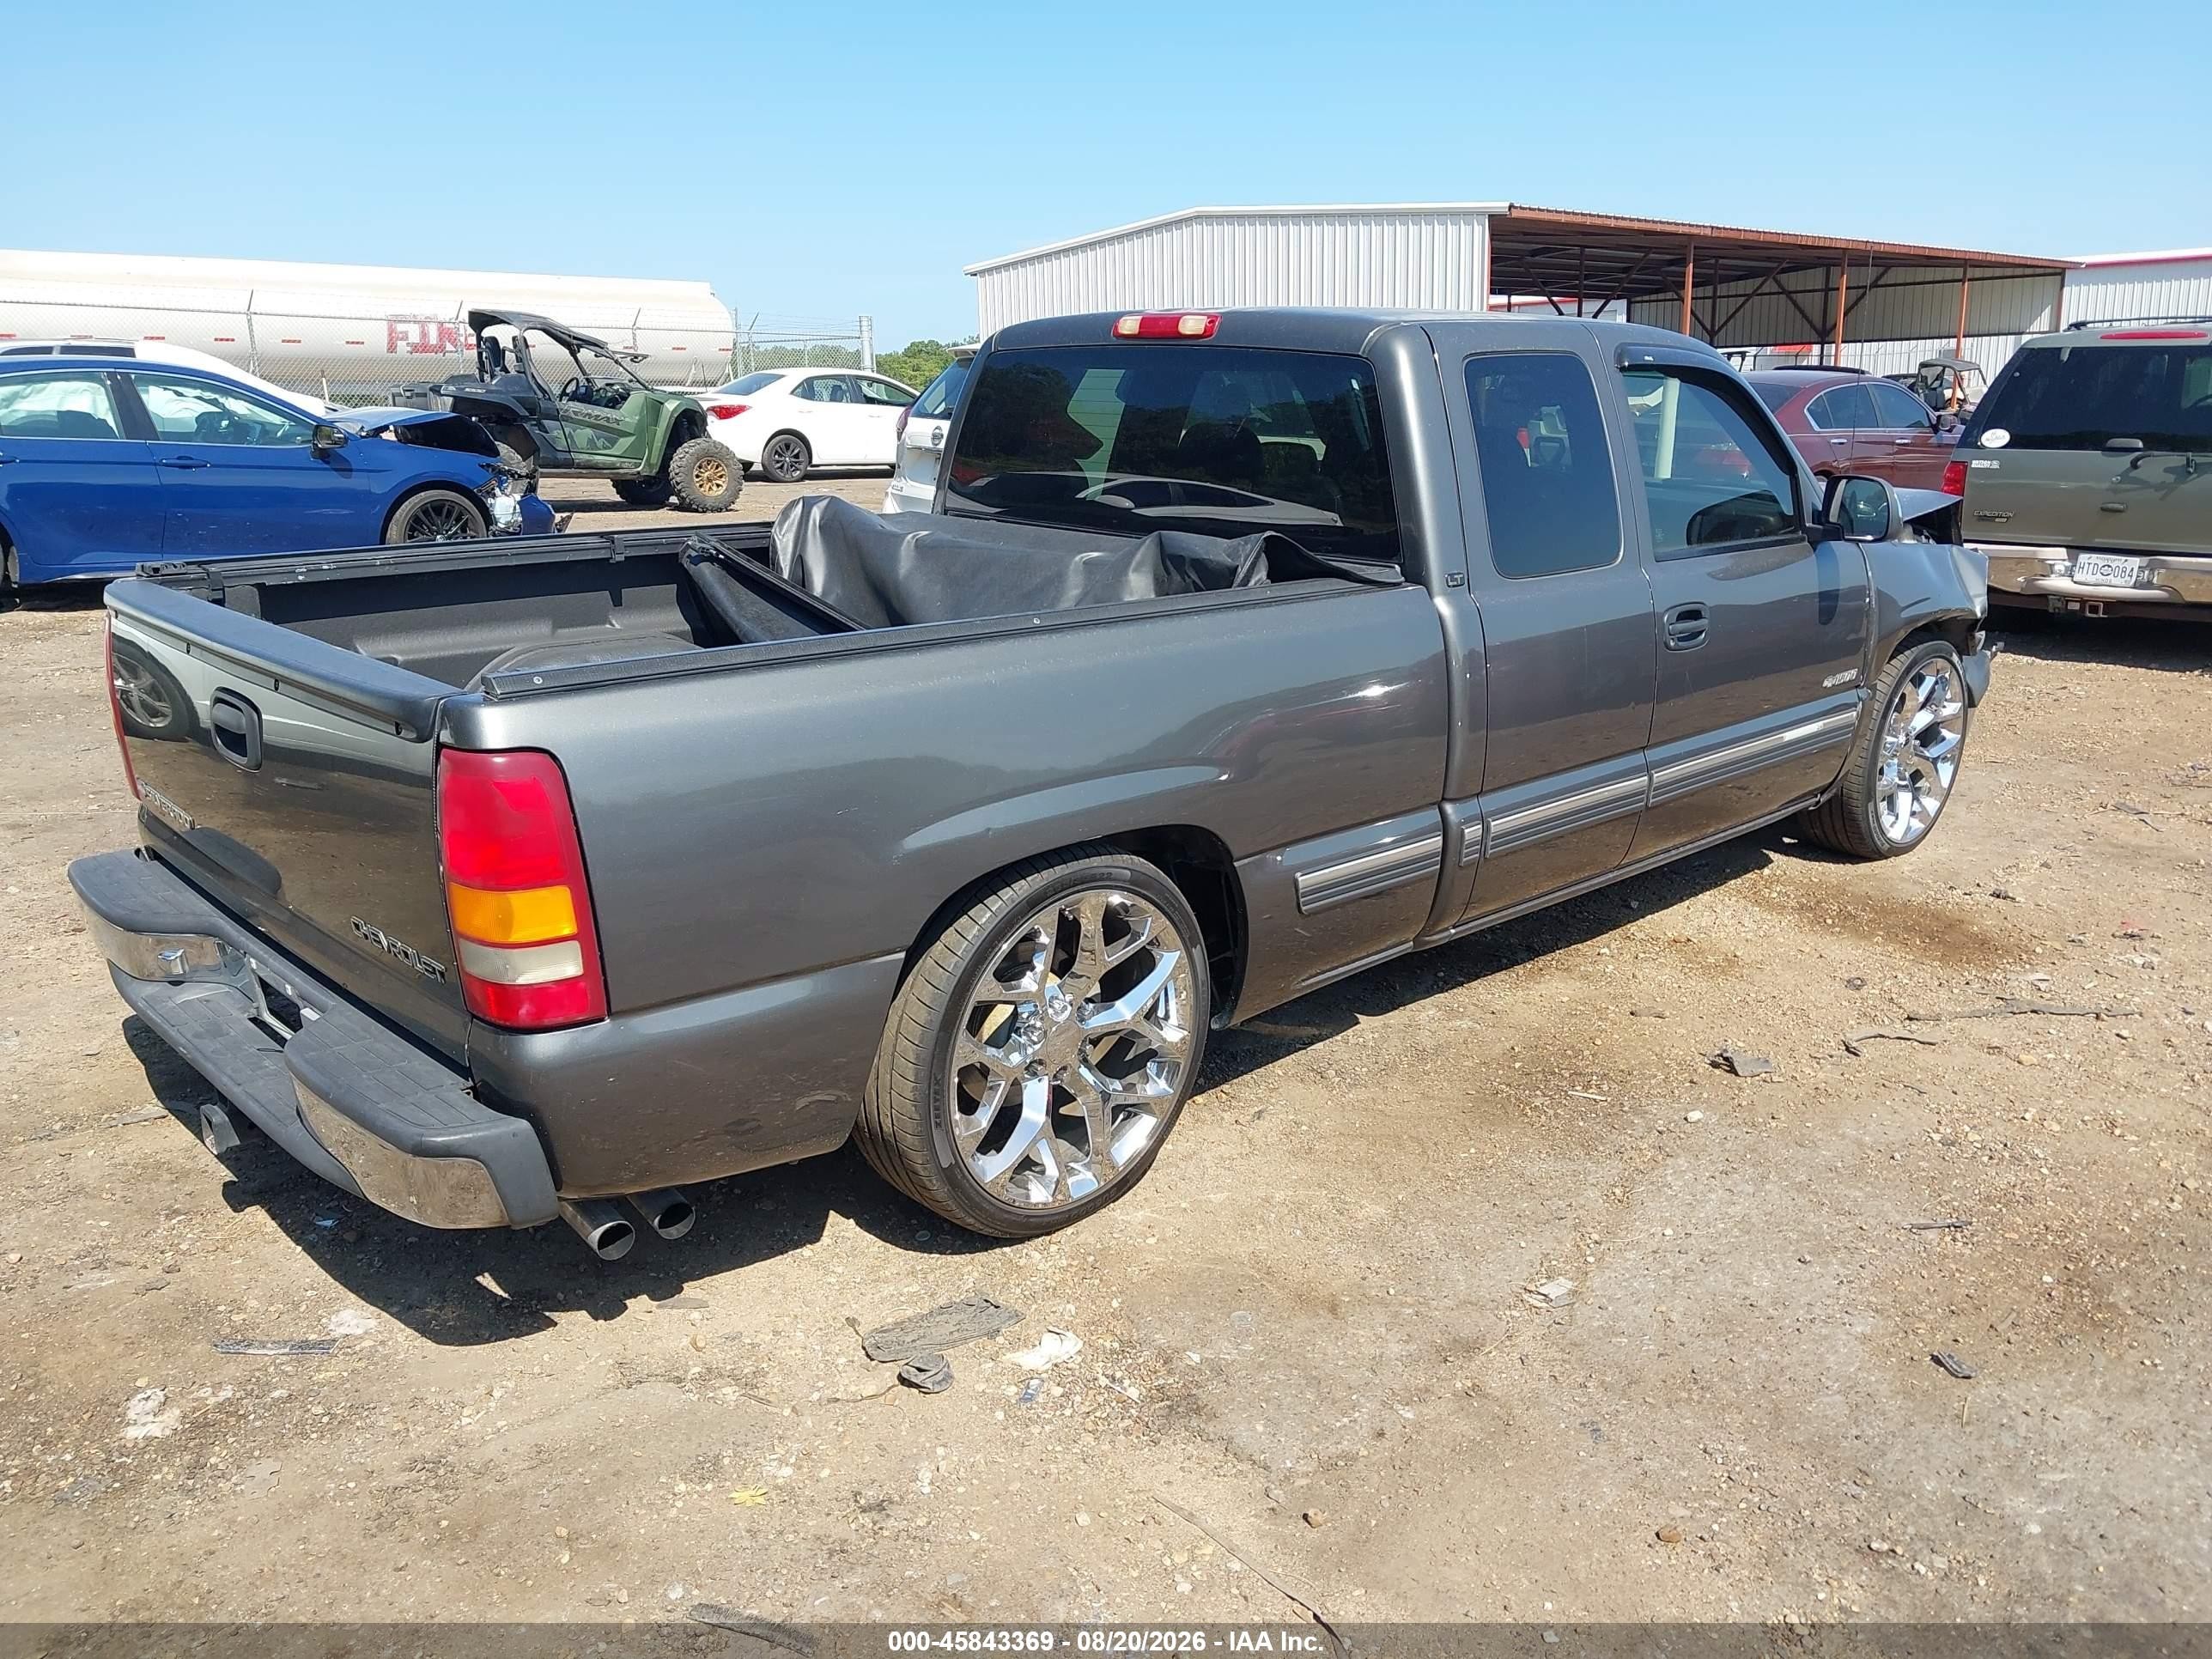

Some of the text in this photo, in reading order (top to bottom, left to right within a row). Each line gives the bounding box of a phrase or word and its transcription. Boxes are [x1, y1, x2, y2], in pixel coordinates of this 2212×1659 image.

[1448, 574, 1464, 586] LT
[2078, 561, 2135, 581] HTD 084
[350, 915, 447, 984] CHEVROLET
